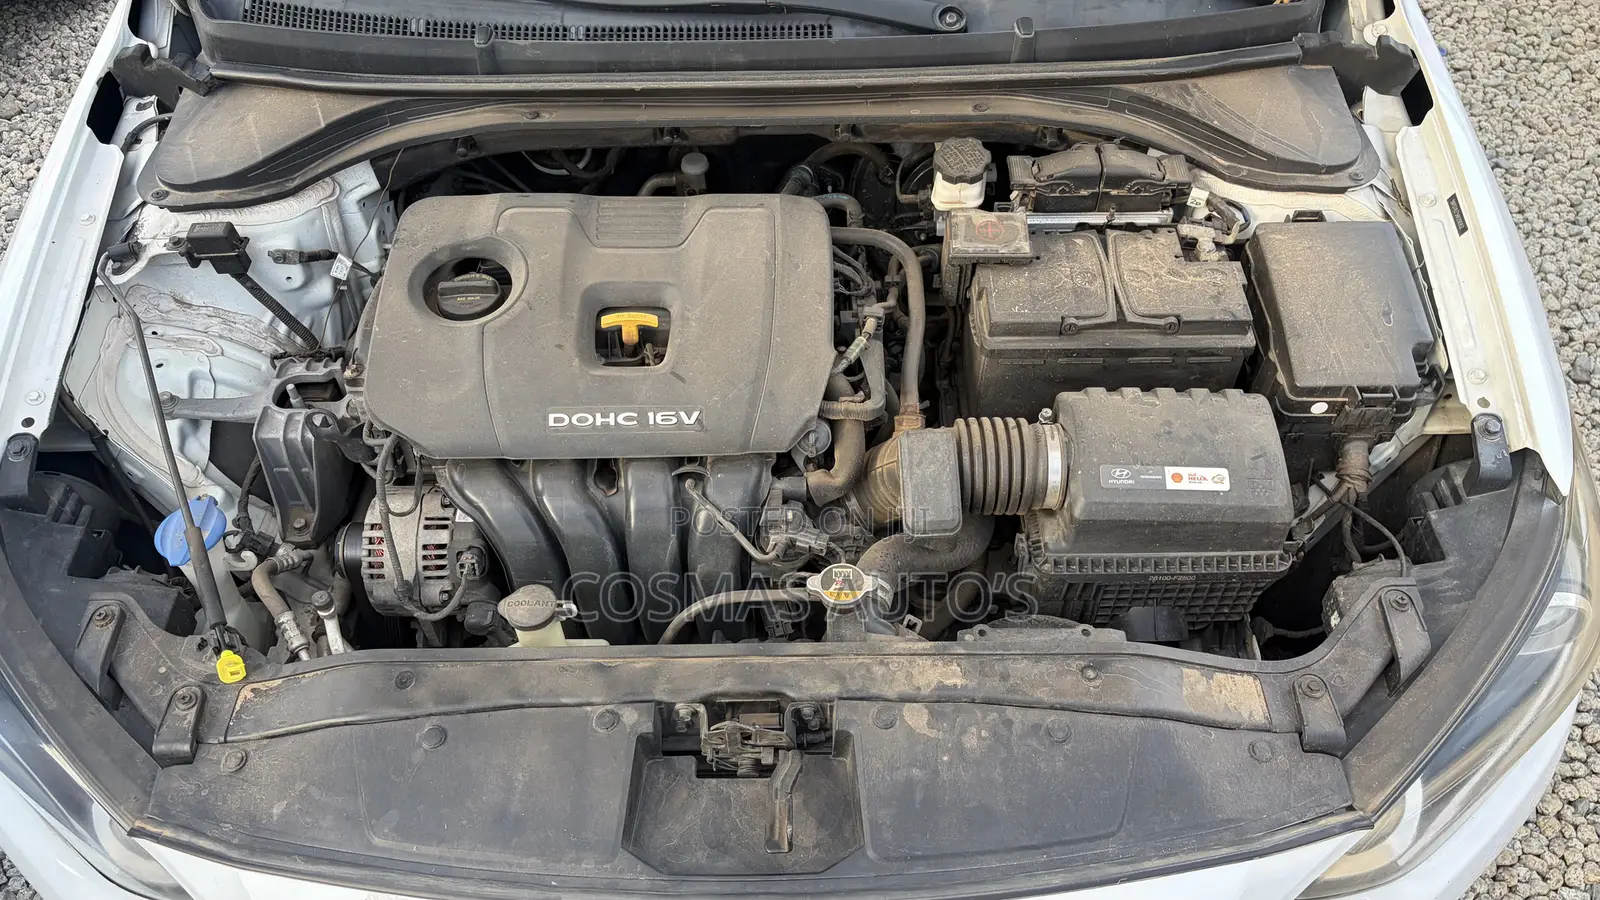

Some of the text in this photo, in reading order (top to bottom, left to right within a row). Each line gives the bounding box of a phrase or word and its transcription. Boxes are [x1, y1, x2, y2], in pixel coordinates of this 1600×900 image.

[548, 410, 700, 427] DOHC 16V
[507, 600, 556, 608] COOLANT
